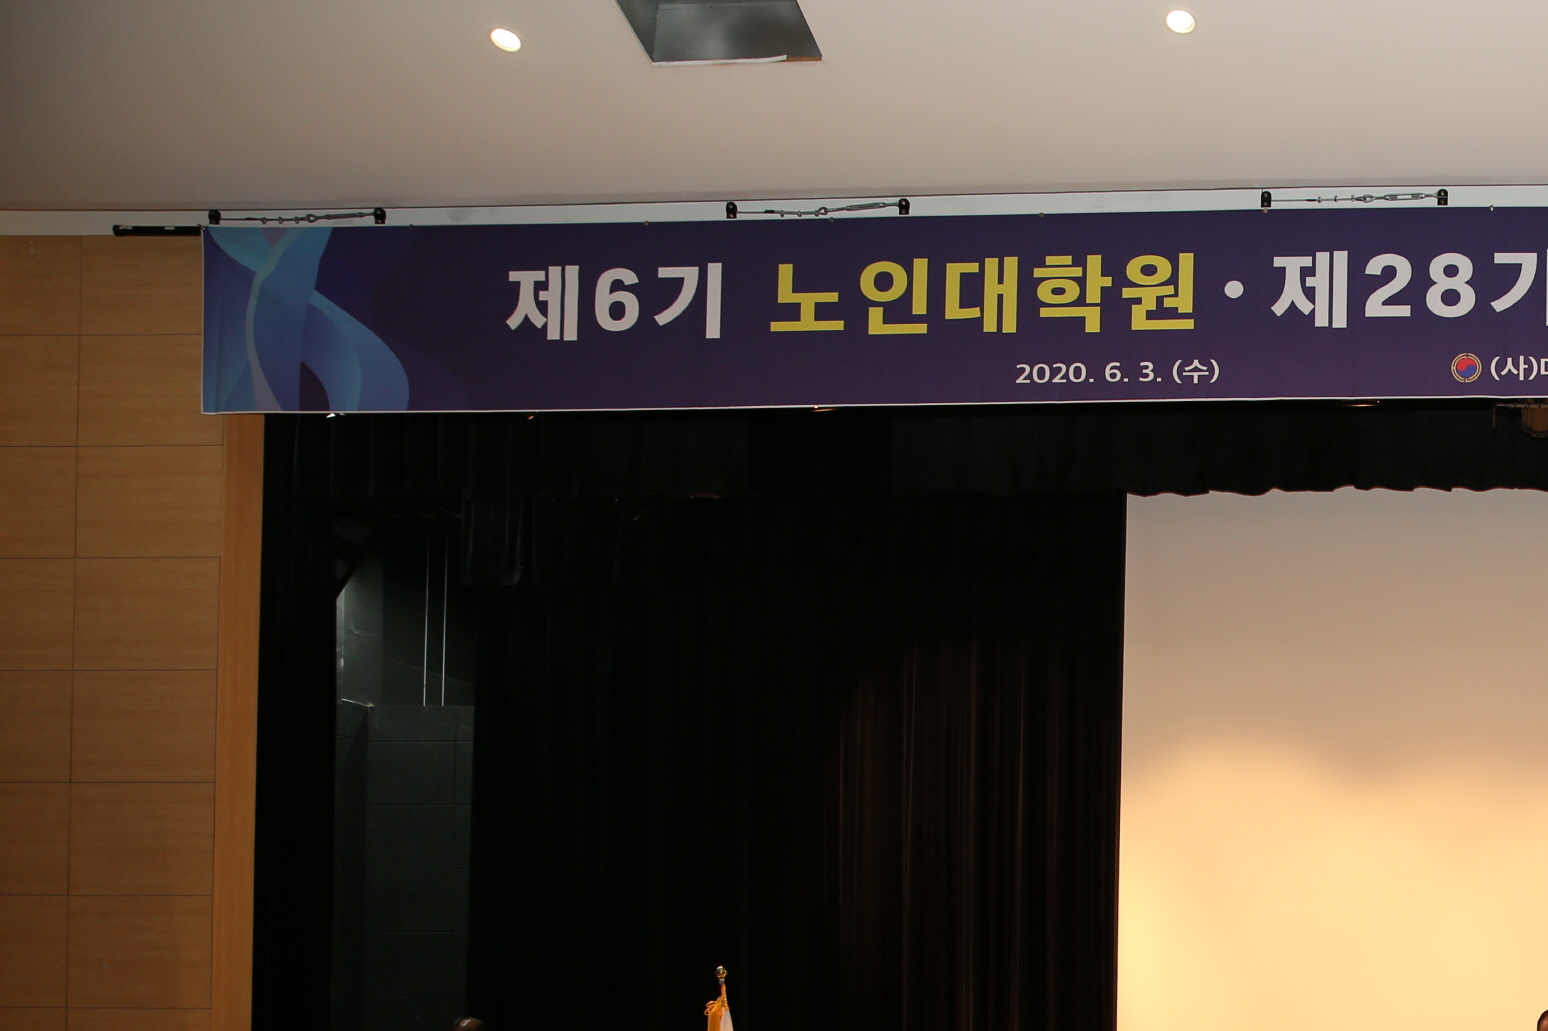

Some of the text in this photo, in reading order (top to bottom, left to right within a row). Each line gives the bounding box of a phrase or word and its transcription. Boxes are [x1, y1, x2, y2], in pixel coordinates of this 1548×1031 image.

[505, 262, 723, 341] 제6기
[770, 252, 1195, 335] 노인대학원
[1015, 358, 1220, 384] 2020. 6. 3. (수)
